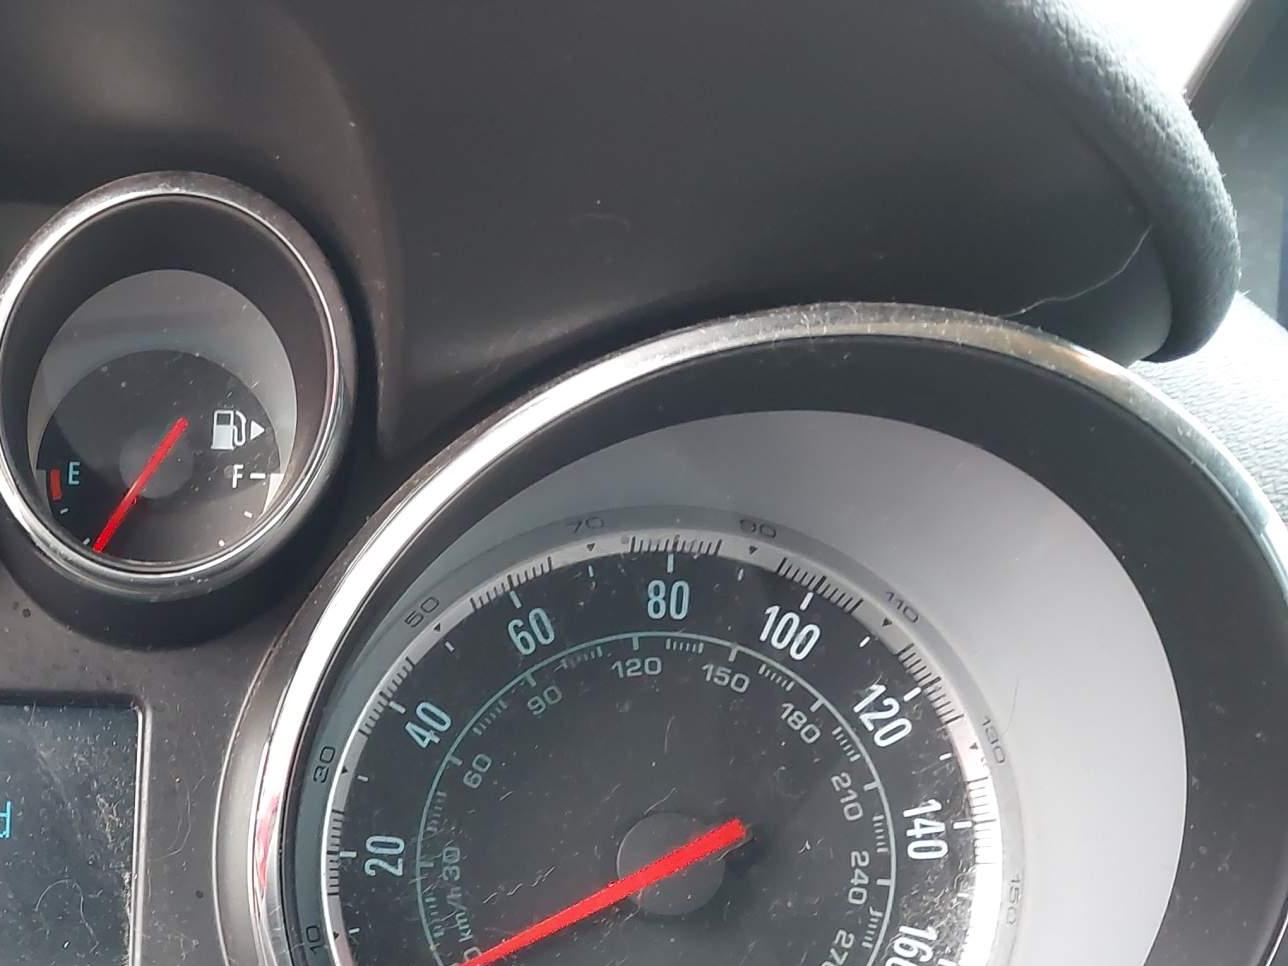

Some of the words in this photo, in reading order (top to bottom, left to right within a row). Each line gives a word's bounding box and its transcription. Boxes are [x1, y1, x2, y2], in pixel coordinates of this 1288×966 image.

[69, 461, 80, 486] E
[232, 464, 244, 488] F
[567, 516, 606, 535] 70
[739, 519, 778, 539] 90
[403, 597, 441, 628] 50
[646, 580, 690, 621] 80
[883, 589, 921, 624] 110
[508, 607, 556, 654] 60
[760, 603, 821, 661] 100
[612, 656, 663, 678] 120
[701, 663, 751, 695] 150
[527, 685, 563, 716] 90
[852, 682, 912, 748] 120
[404, 700, 452, 750] 40
[779, 702, 821, 745] 180
[979, 716, 1008, 766] 130
[312, 745, 337, 784] 30
[463, 752, 492, 790] 60
[831, 773, 864, 822] 210
[902, 799, 948, 861] 140
[364, 836, 405, 876] 20
[442, 847, 460, 881] 30
[846, 849, 871, 907] 240
